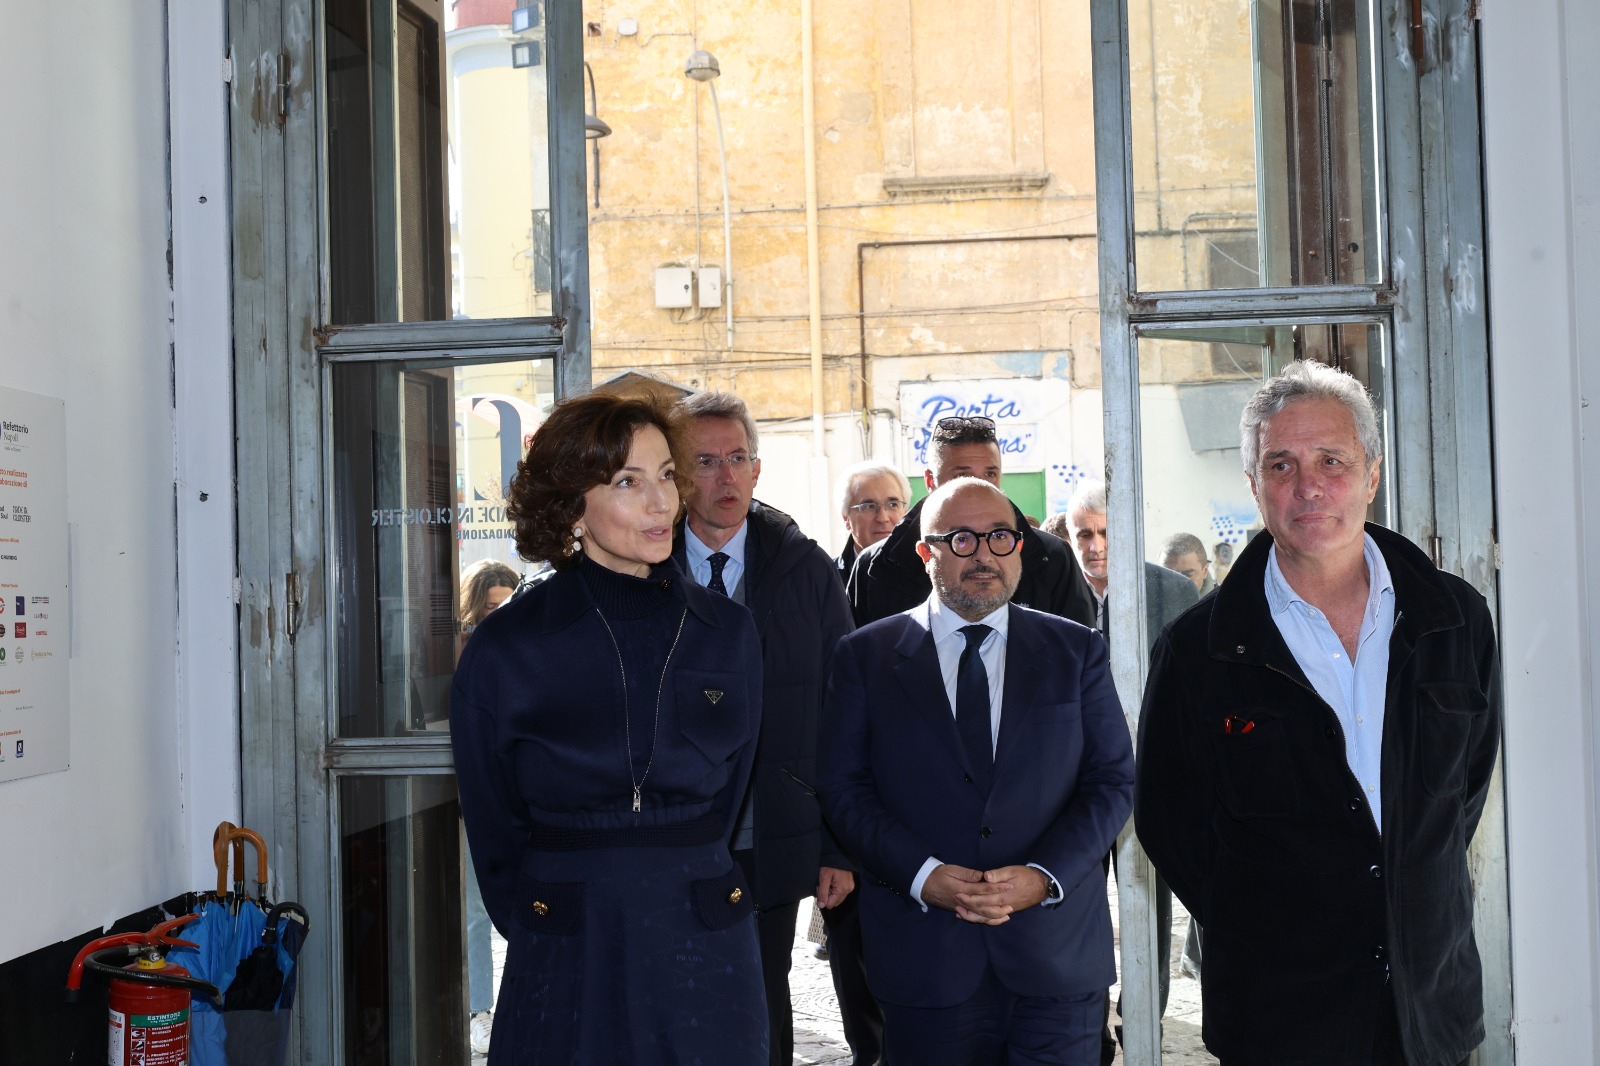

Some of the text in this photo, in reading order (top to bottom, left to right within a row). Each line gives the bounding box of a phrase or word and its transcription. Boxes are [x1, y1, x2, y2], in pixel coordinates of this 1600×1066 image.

[921, 393, 1021, 427] Porta
[3, 421, 29, 434] Refettorio
[4, 432, 19, 443] Napoli
[676, 954, 704, 963] PRADA
